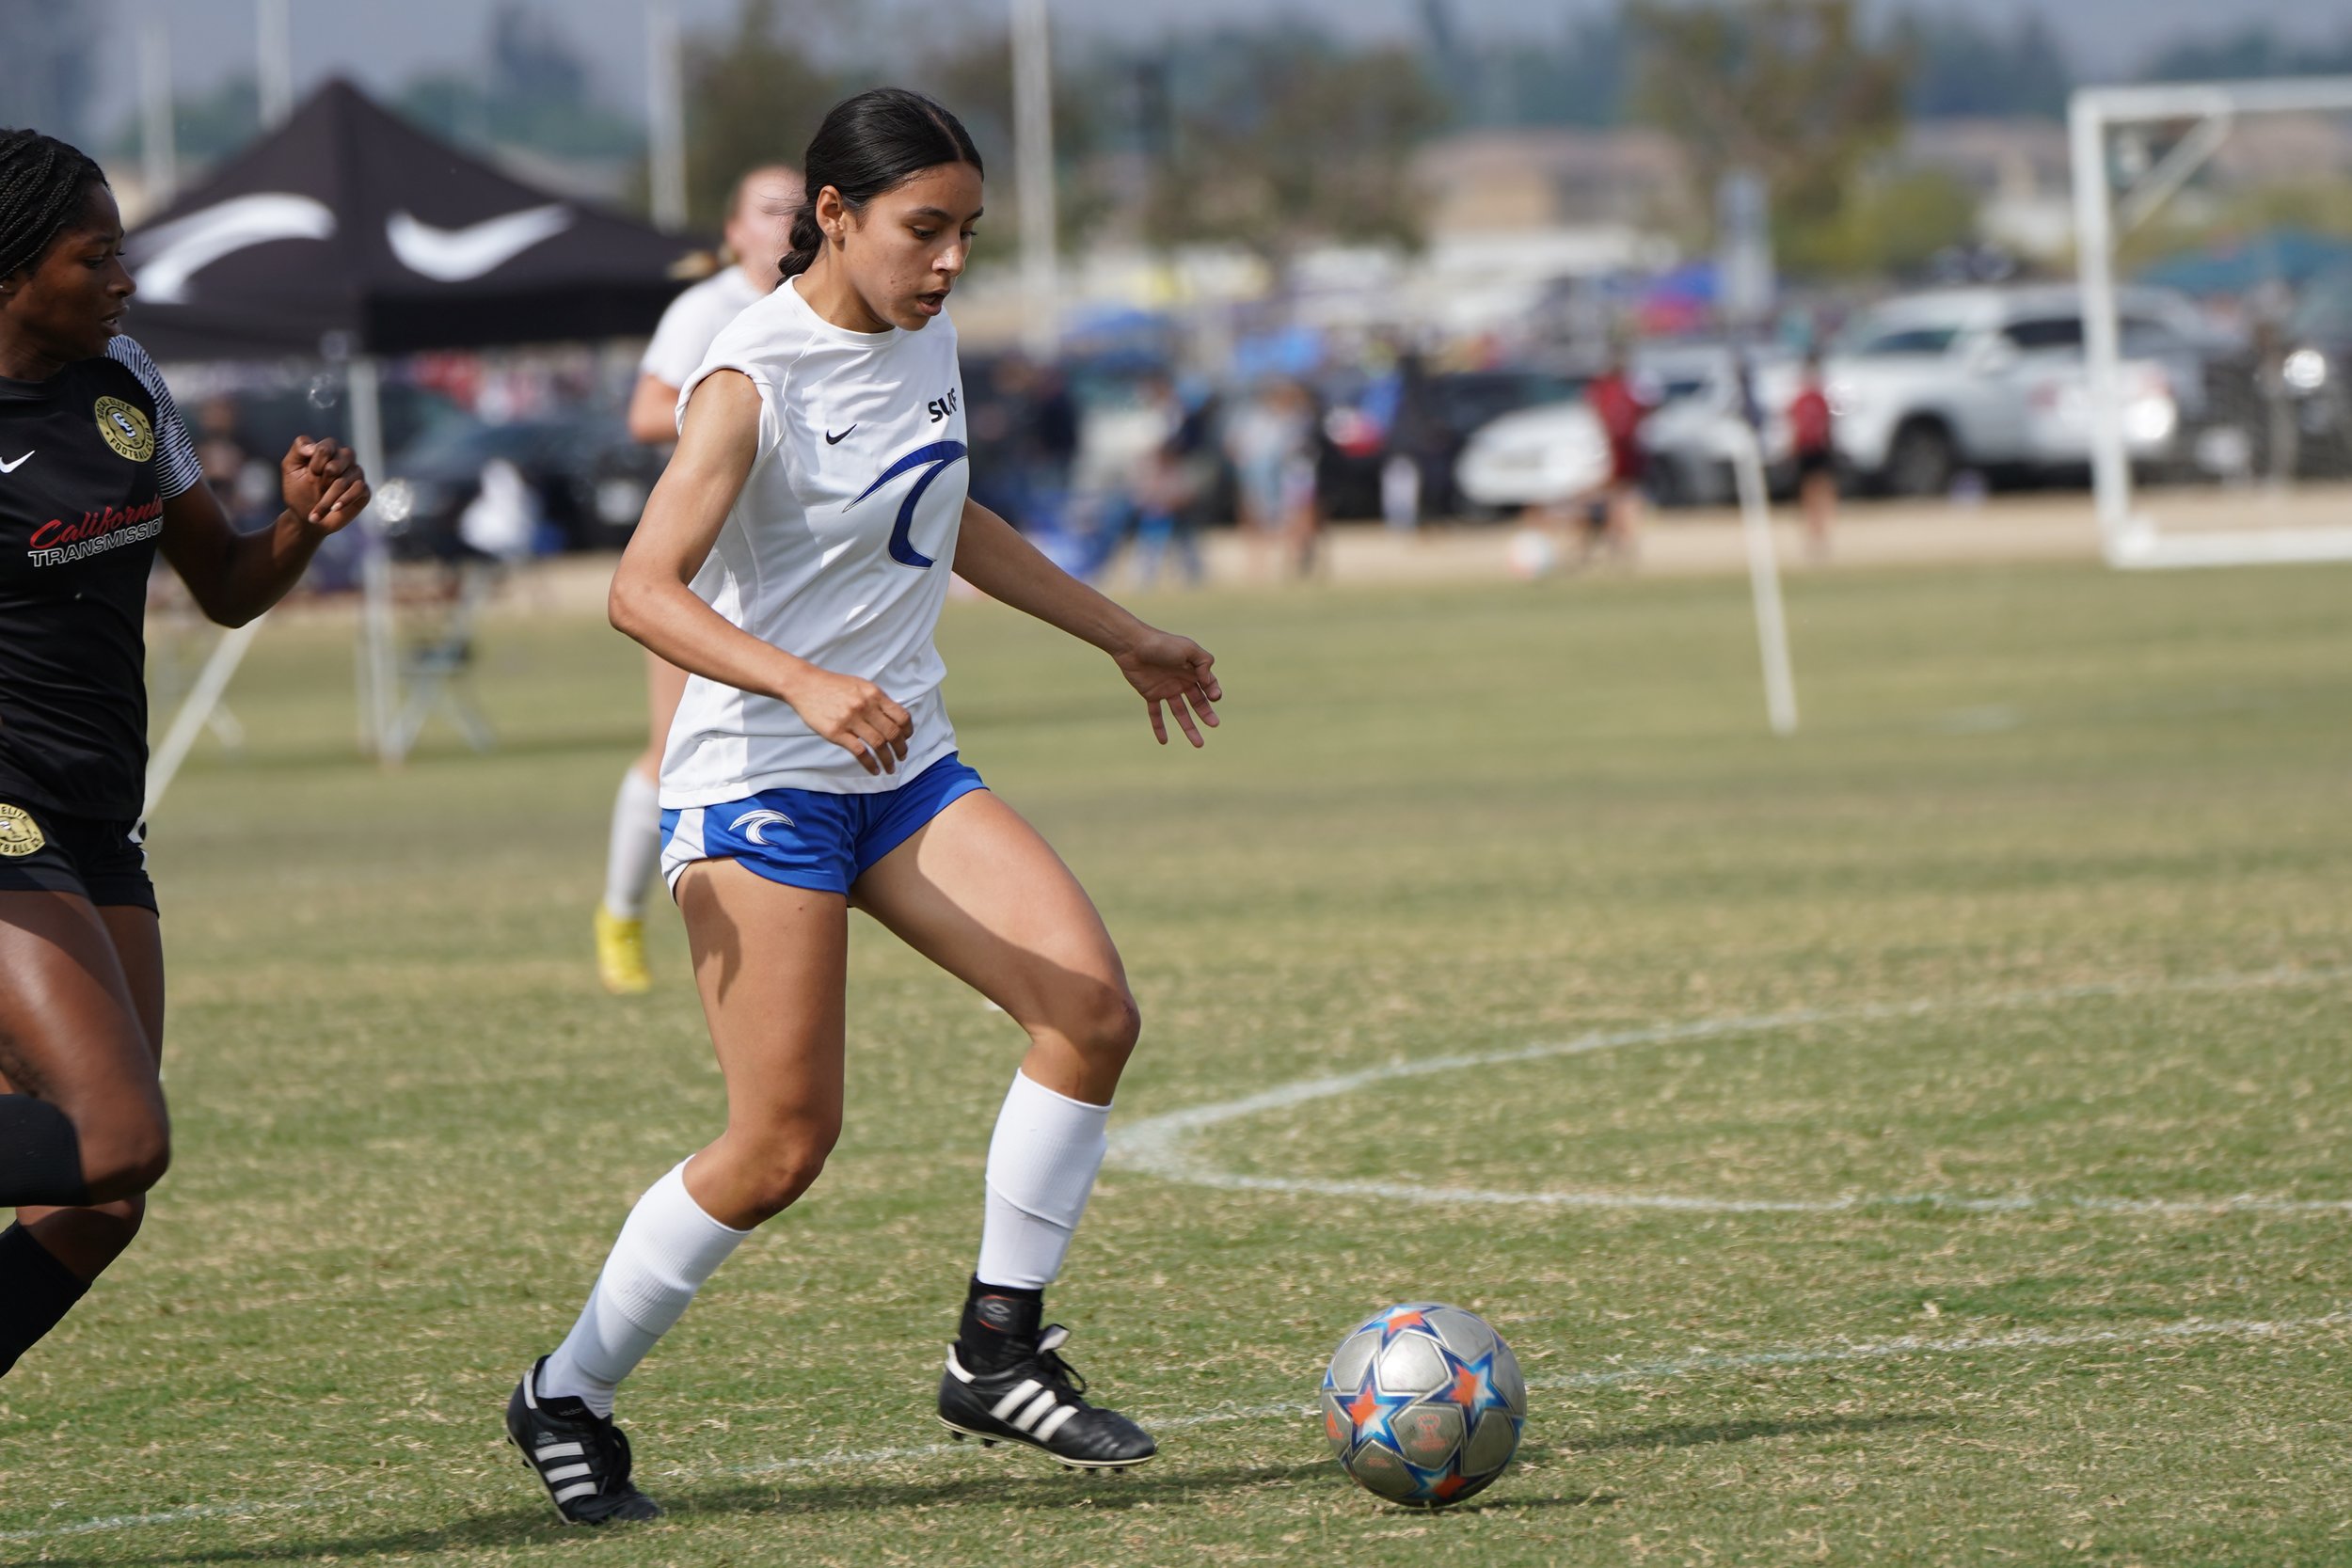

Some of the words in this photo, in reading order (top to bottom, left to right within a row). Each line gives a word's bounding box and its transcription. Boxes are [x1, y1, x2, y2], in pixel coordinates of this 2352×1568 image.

[108, 398, 132, 412] ELITE
[110, 438, 150, 459] FOOTBALL
[145, 427, 153, 452] CLUB
